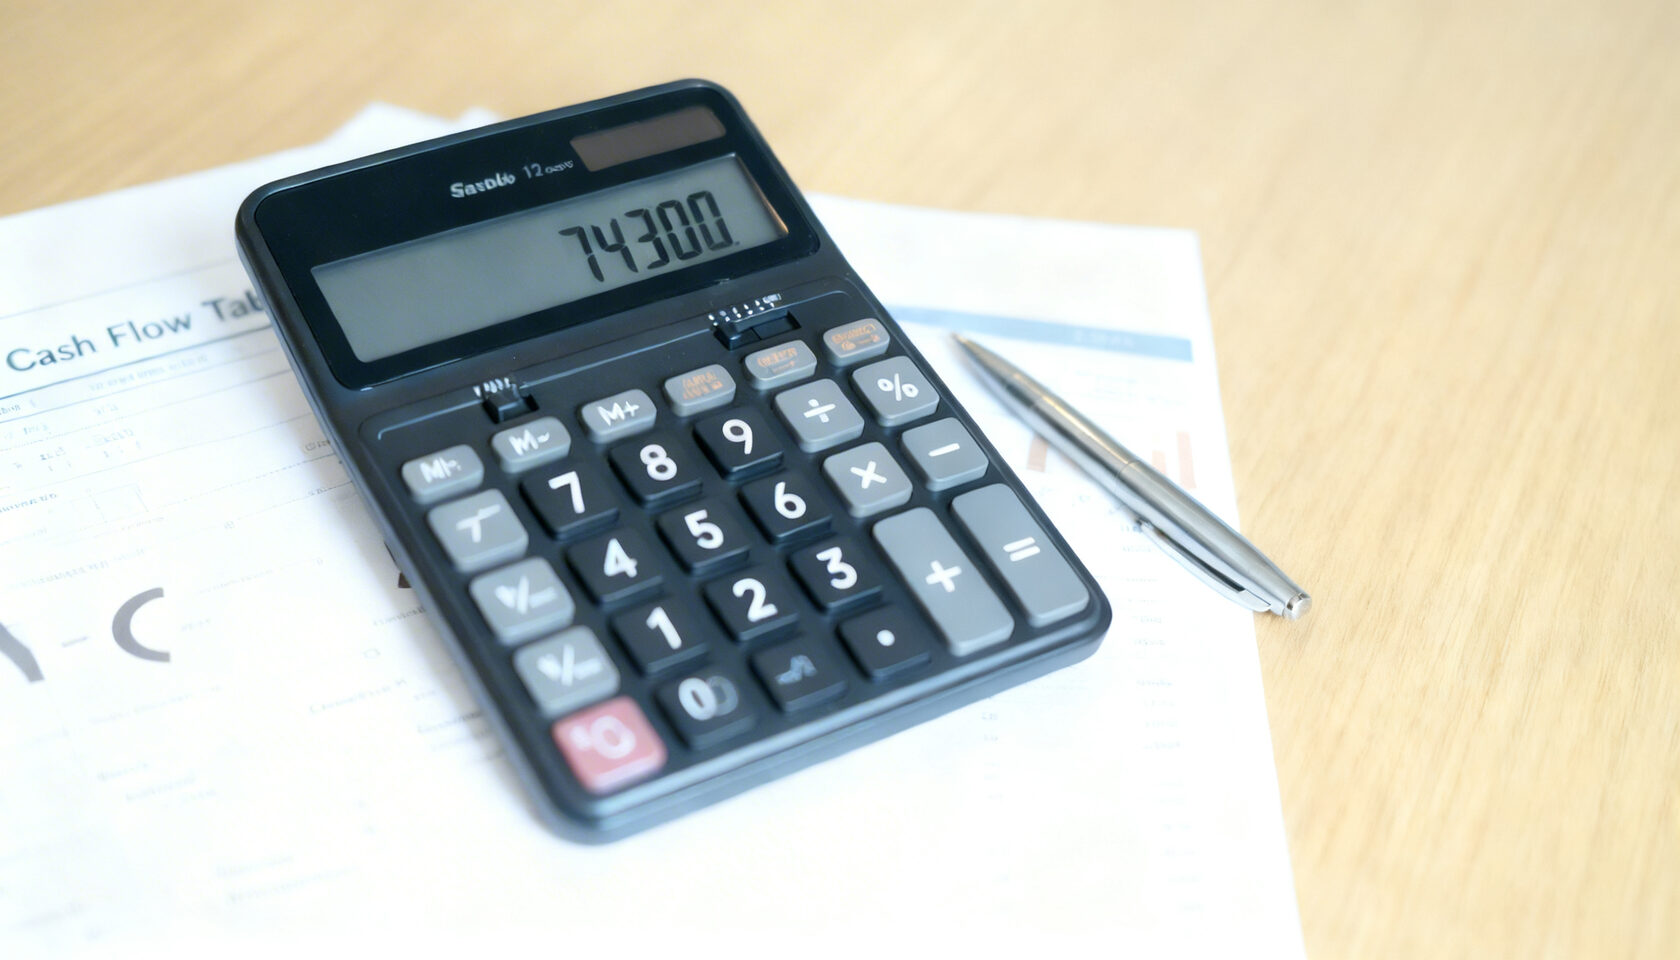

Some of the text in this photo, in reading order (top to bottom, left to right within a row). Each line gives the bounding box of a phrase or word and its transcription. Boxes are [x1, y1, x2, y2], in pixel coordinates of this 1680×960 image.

[522, 163, 544, 179] 12
[6, 334, 97, 372] Cash
[106, 312, 192, 348] Flow
[597, 400, 640, 427] M+
[722, 418, 753, 455] 9
[639, 443, 678, 481] 8
[548, 470, 586, 514] 7
[774, 481, 807, 519] 6
[684, 509, 724, 549] 5
[603, 538, 637, 578] 4
[816, 546, 858, 590] 3
[732, 577, 779, 622] 2
[646, 606, 682, 650] 1
